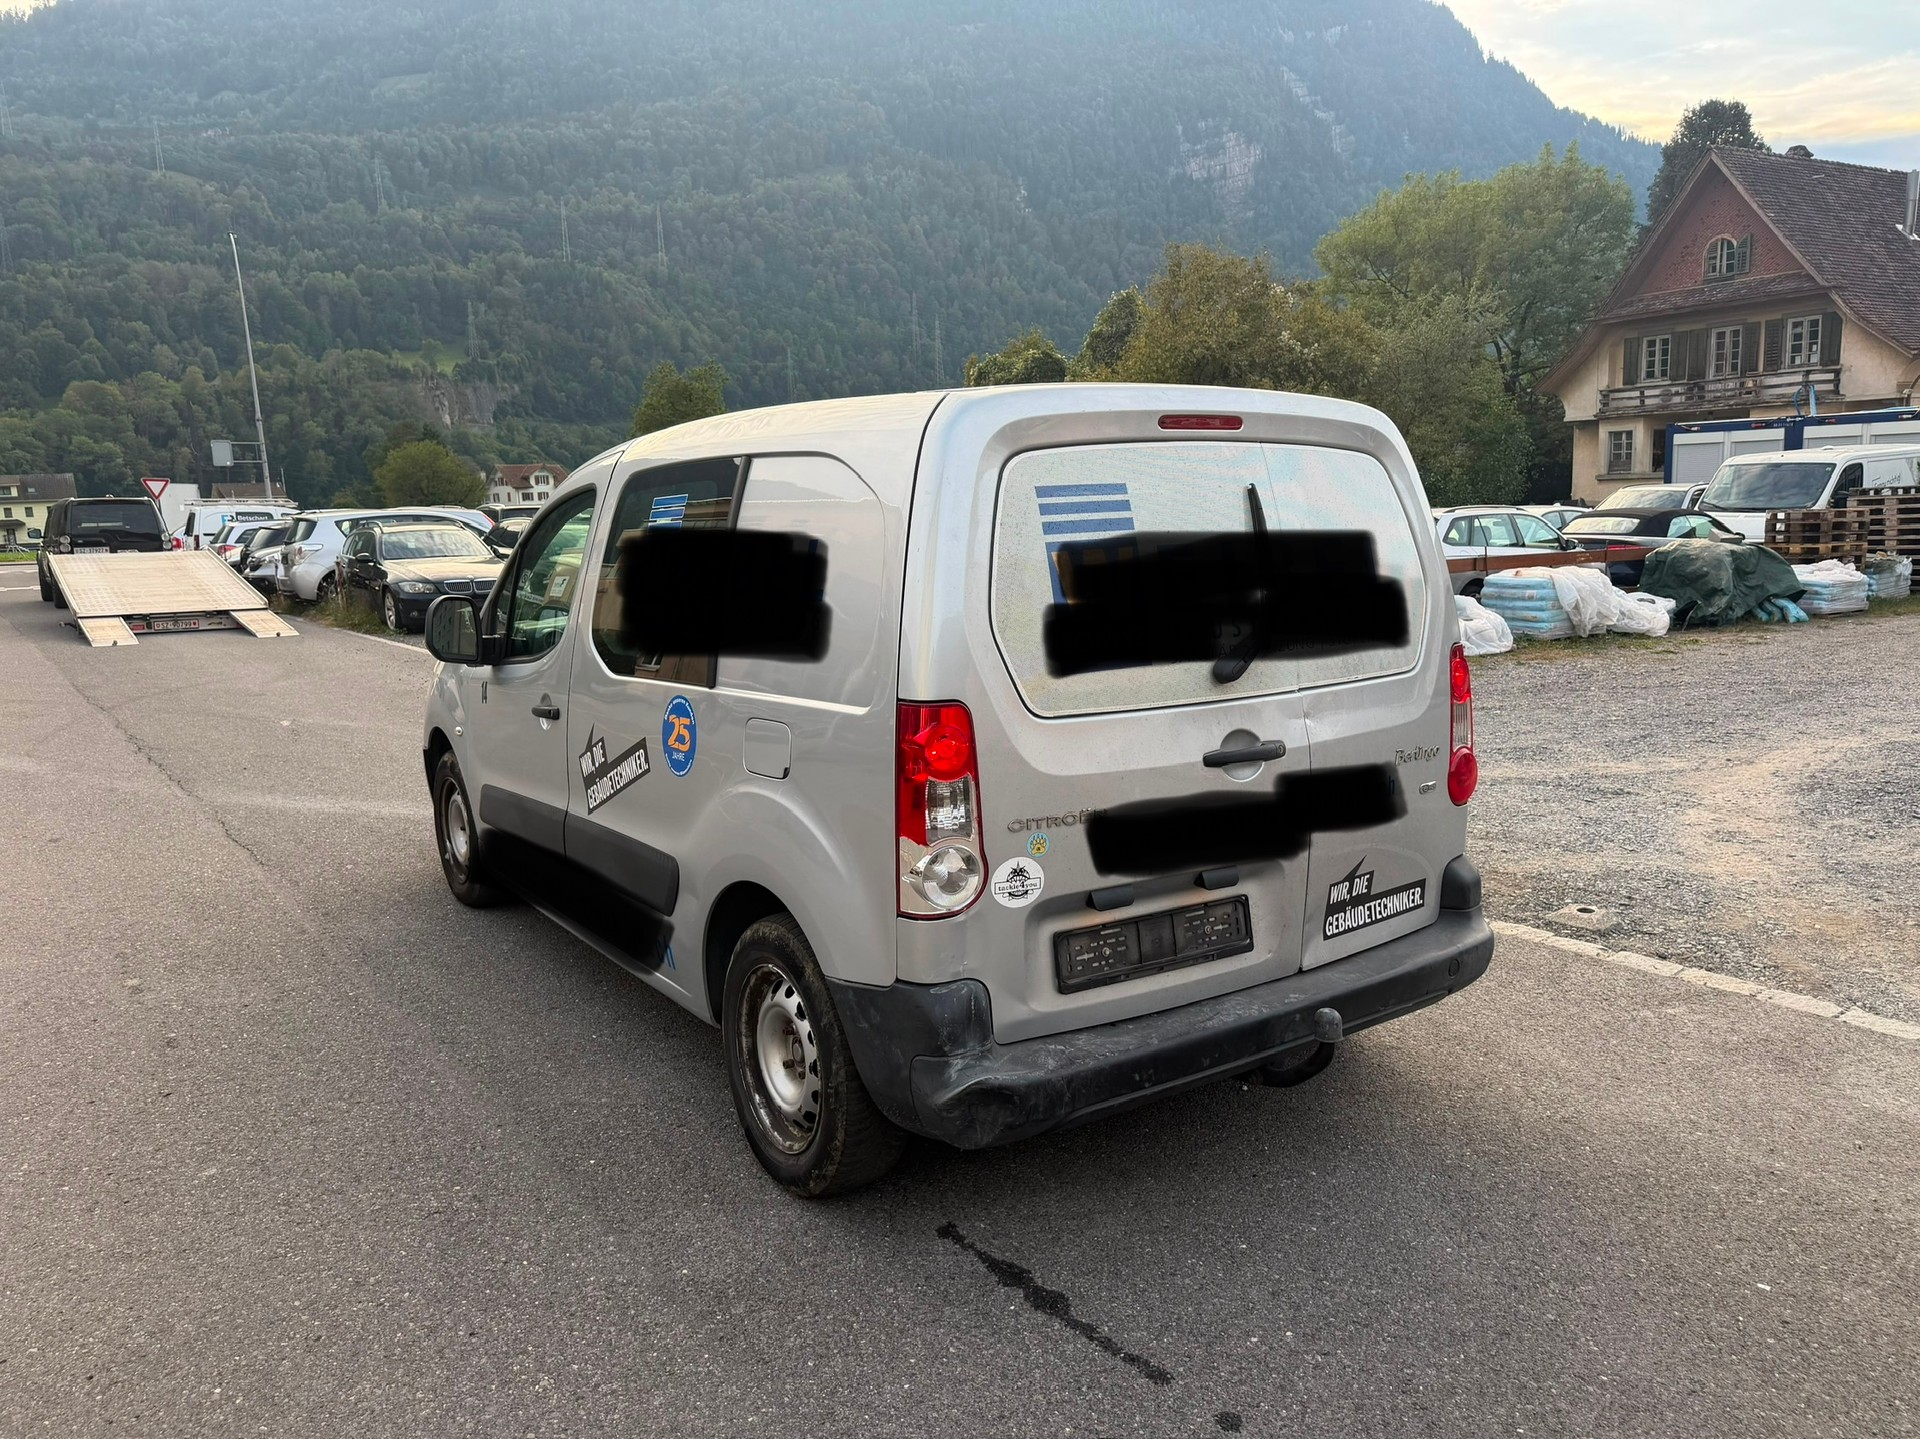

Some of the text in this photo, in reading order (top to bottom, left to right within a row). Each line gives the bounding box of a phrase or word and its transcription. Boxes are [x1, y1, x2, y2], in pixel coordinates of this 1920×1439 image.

[481, 680, 488, 705] 14
[668, 714, 690, 752] 25
[592, 741, 605, 768] DIE
[672, 751, 685, 762] JAHRE
[1395, 745, 1439, 767] Berlingo
[587, 748, 649, 809] GEBÄUDETECHNIKER.
[998, 880, 1038, 892] tackle4you
[1329, 874, 1370, 905] WIR, DIE
[1325, 887, 1424, 936] GEBÄUDETECHNIKER.
